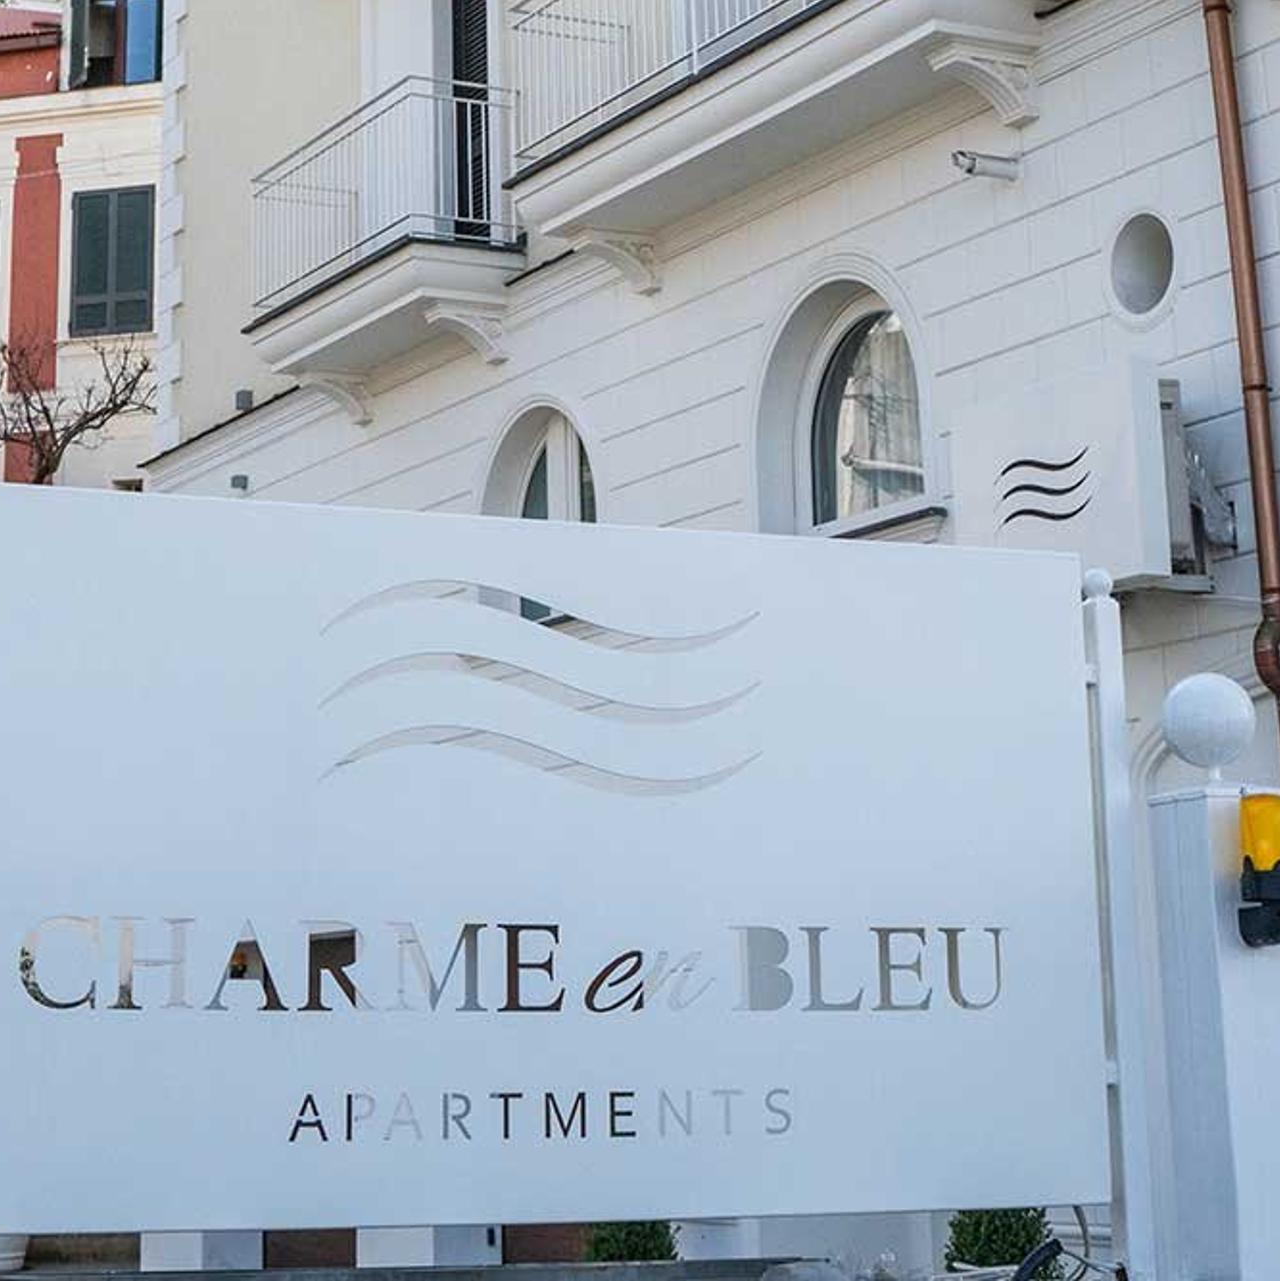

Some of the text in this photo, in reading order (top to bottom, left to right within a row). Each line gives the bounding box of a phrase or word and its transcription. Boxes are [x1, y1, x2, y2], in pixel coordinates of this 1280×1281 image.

[19, 914, 1010, 1014] CHARME en BLEU
[287, 1087, 794, 1142] APARTMENTS
